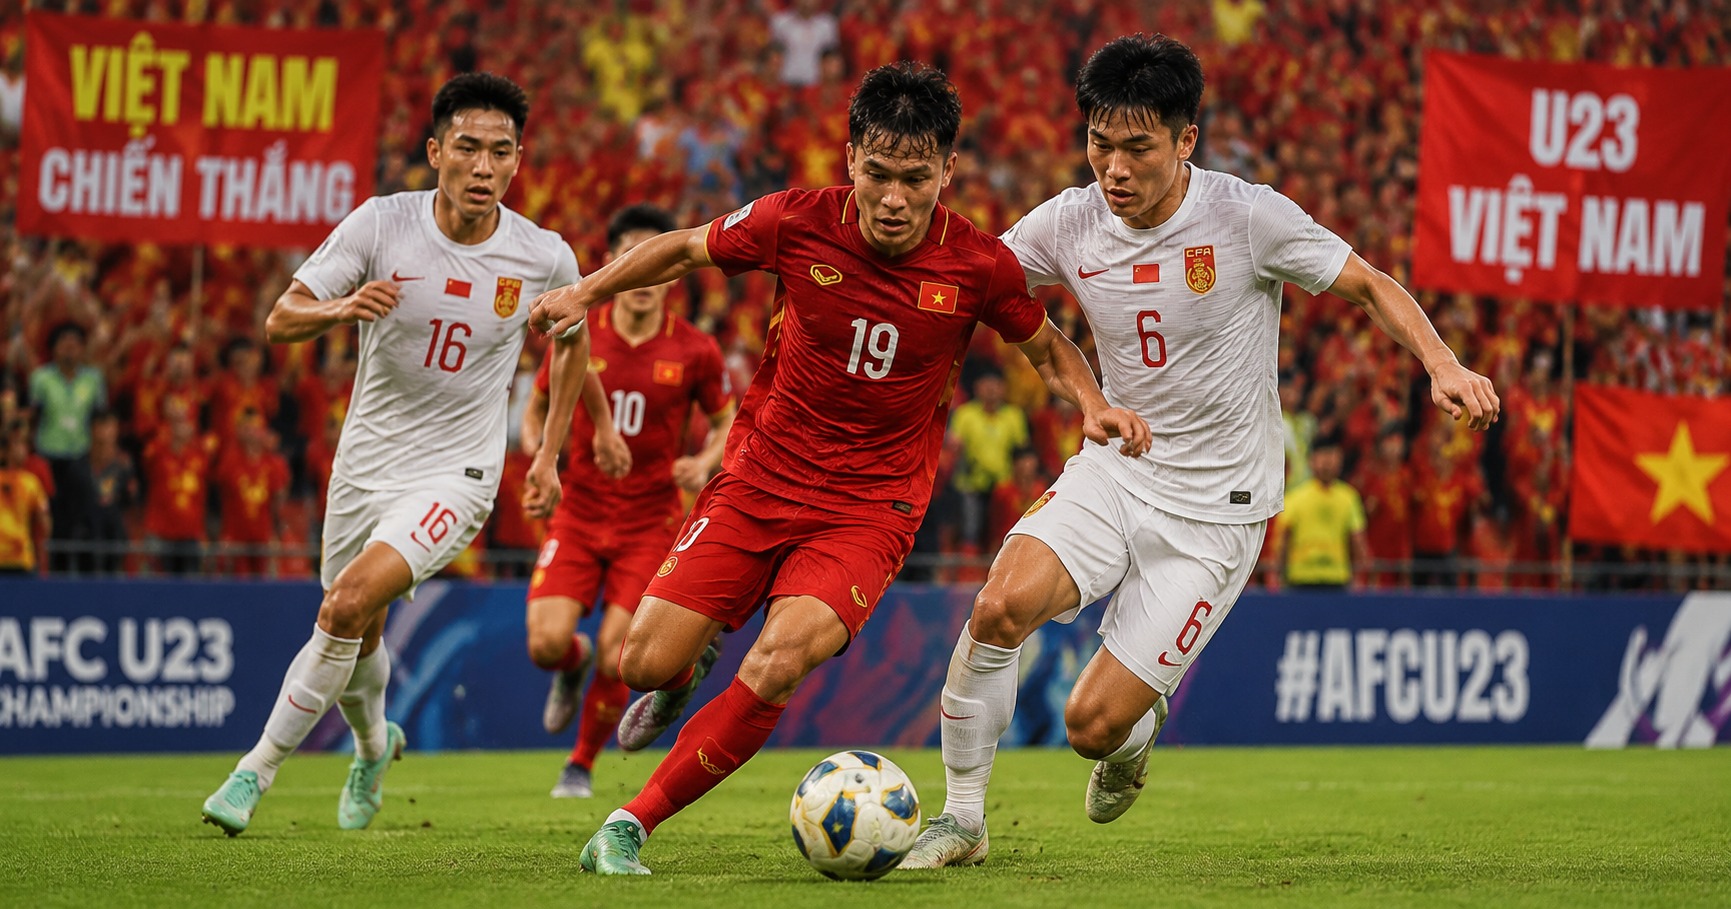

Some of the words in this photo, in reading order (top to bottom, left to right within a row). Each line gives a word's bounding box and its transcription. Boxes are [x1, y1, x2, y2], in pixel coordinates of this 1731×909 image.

[69, 31, 191, 138] VIỆT
[202, 53, 338, 132] NAM
[1529, 87, 1640, 173] U23
[38, 136, 183, 219] CHIẾN
[196, 139, 356, 225] THẮNG
[1186, 247, 1212, 258] CFA
[1448, 174, 1568, 284] VIỆT
[1578, 195, 1706, 278] NAM
[424, 318, 472, 373] 16
[847, 317, 900, 380] 19
[1136, 309, 1168, 368] 6
[610, 389, 647, 437] 10
[419, 501, 458, 545] 16
[0, 616, 108, 683] AFC
[118, 616, 235, 684] U23
[1175, 600, 1213, 656] 6
[1274, 628, 1530, 724] #AFCU23
